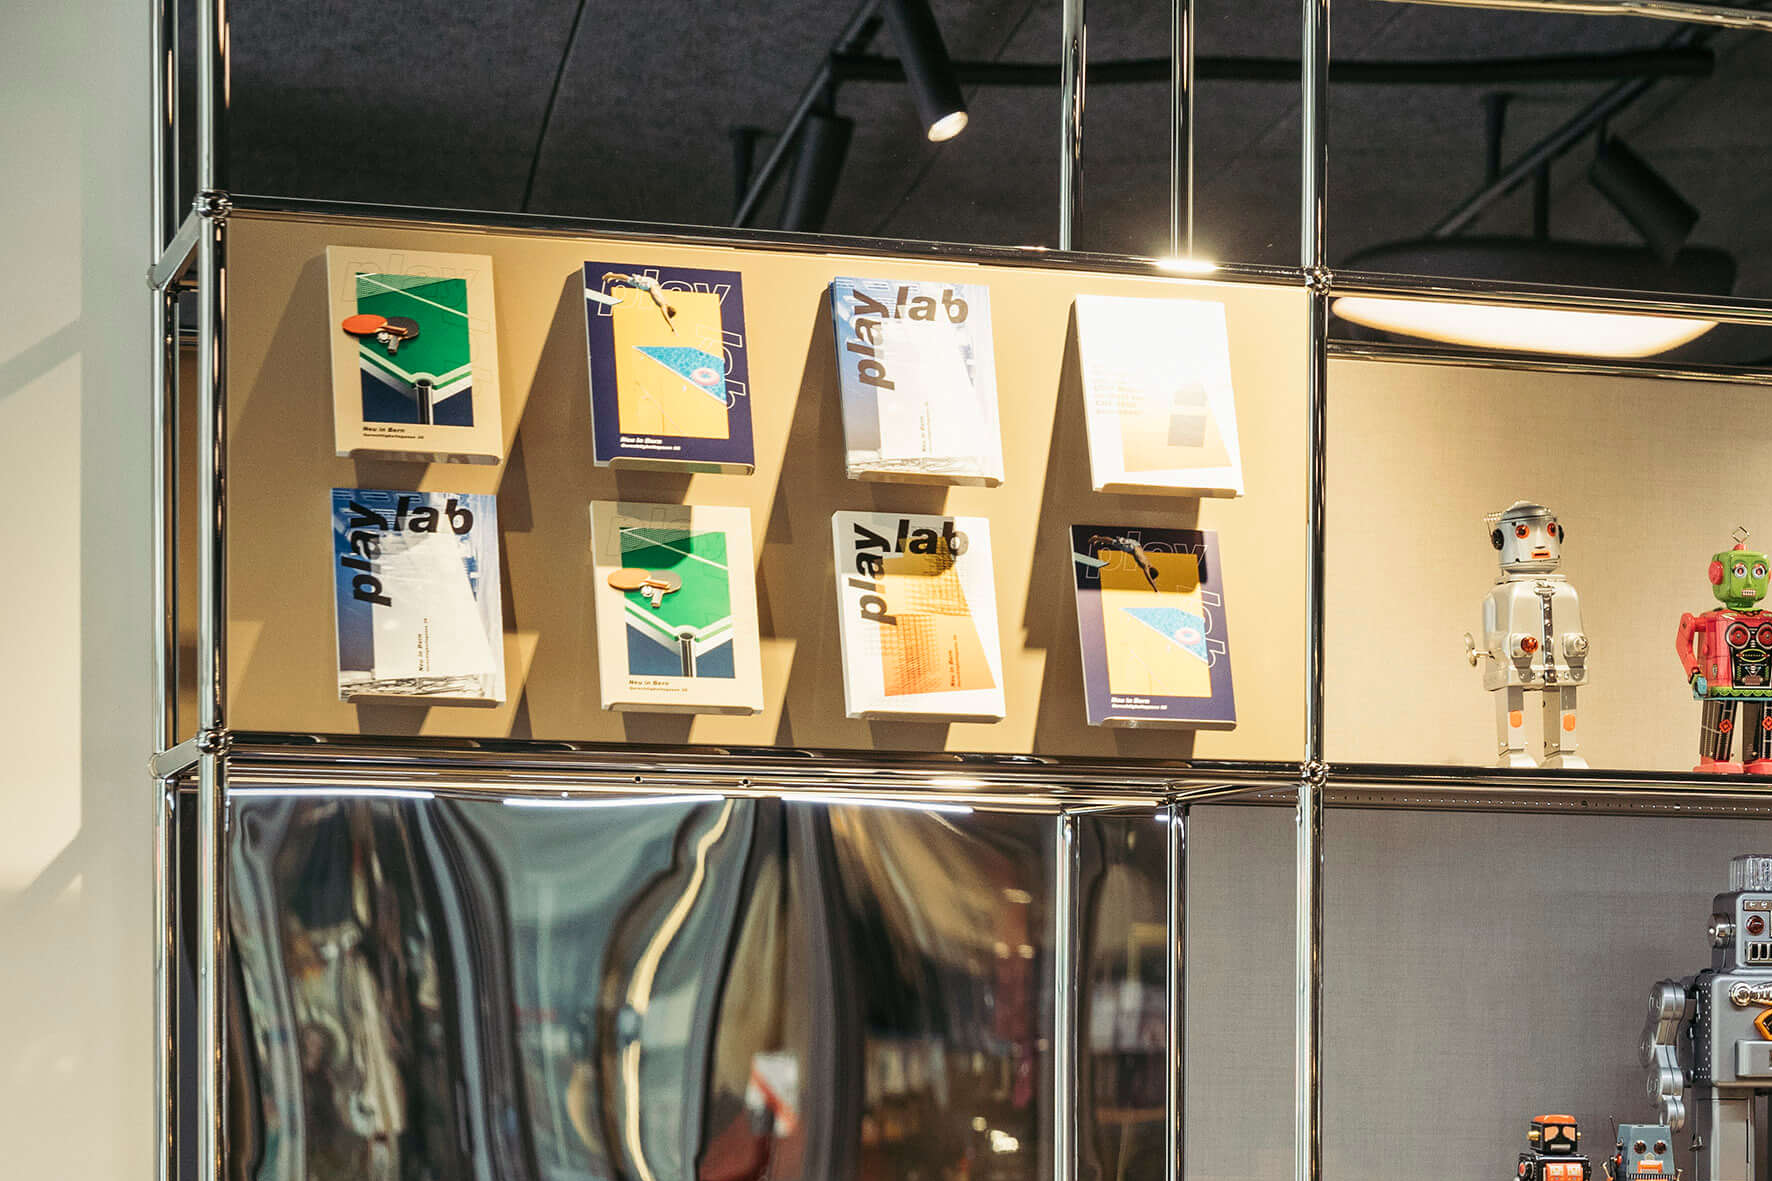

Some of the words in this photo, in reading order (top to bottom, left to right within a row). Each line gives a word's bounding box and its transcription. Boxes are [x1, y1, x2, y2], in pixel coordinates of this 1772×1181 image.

[847, 289, 895, 390] play
[895, 286, 968, 323] lab
[394, 496, 473, 535] lab
[895, 519, 969, 559] lab
[341, 500, 392, 607] play
[848, 522, 897, 626] play
